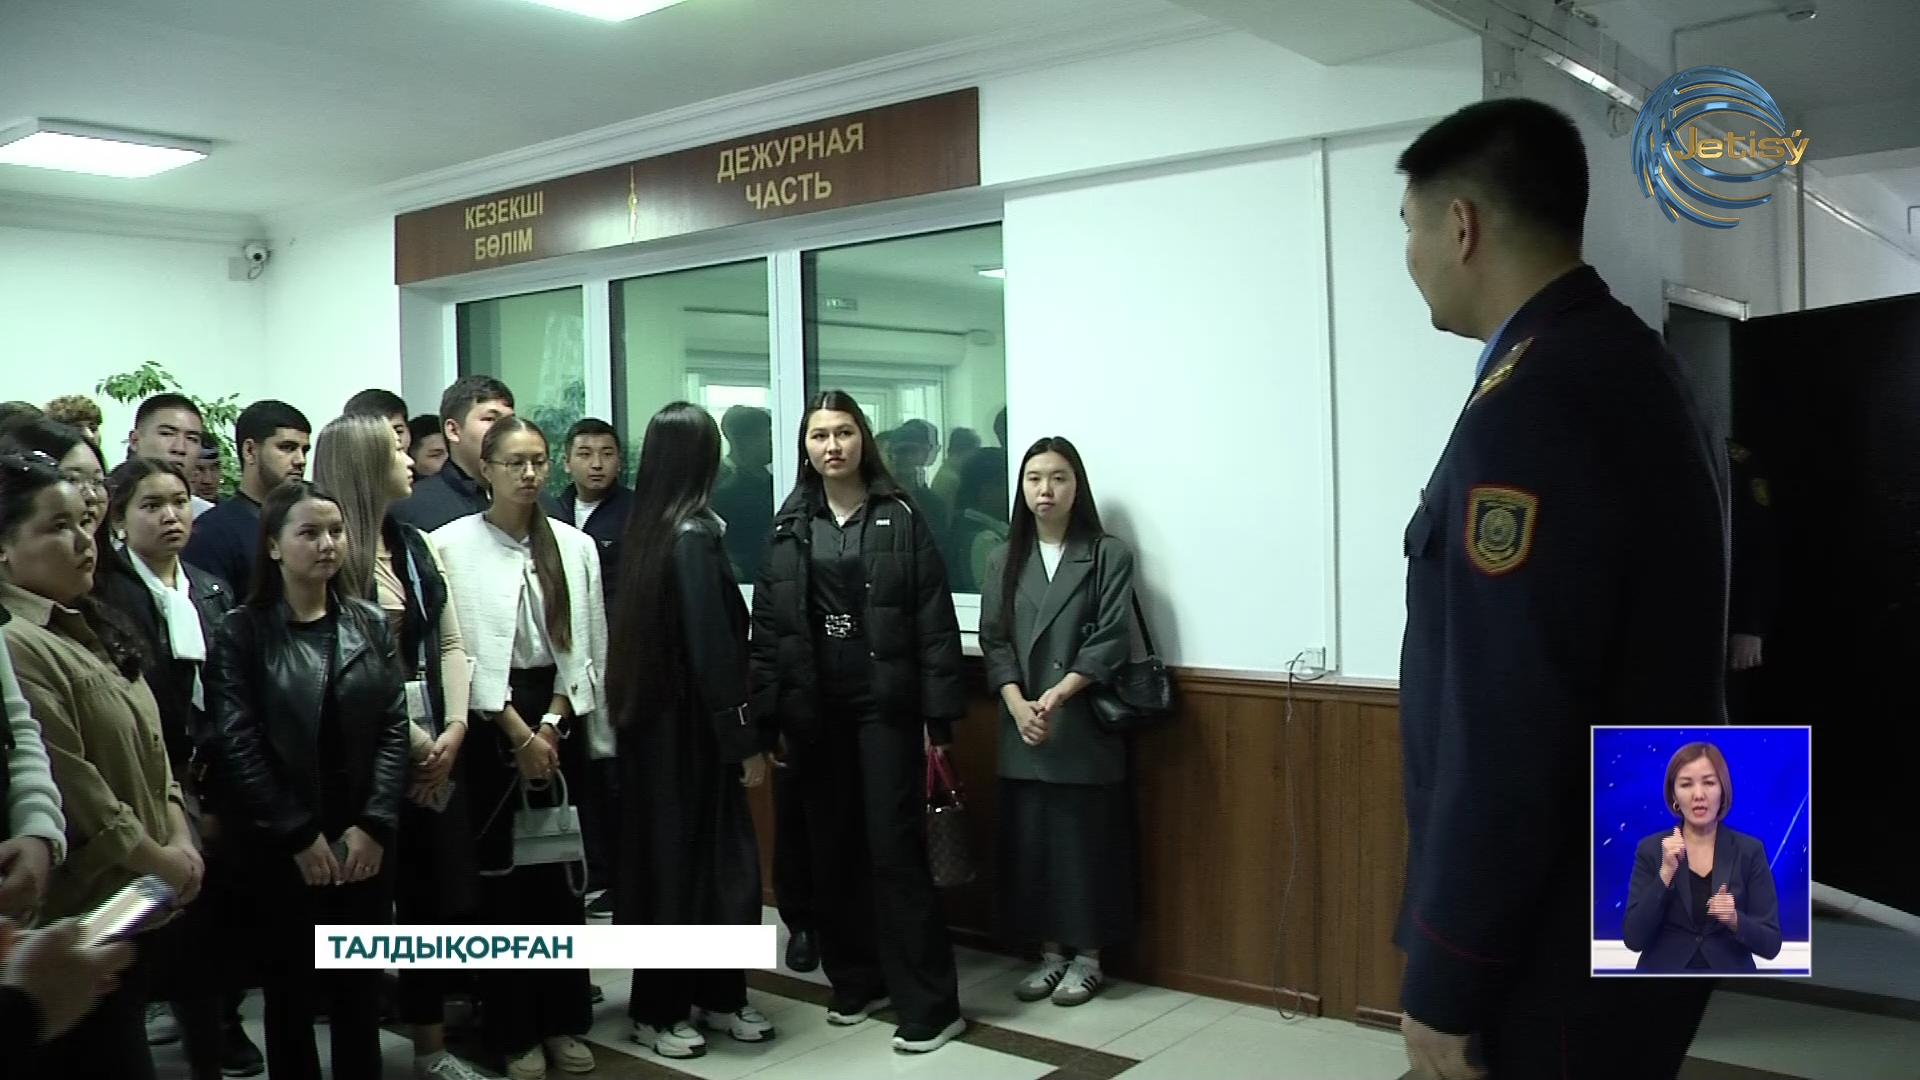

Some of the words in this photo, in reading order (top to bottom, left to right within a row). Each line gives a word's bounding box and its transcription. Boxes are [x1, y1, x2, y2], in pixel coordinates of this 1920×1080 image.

[717, 122, 864, 183] ДЕЖУРНАЯ
[465, 190, 544, 230] КЕЗЕКШІ
[746, 171, 832, 210] ЧАСТЬ
[475, 227, 533, 261] БӨЛІМ
